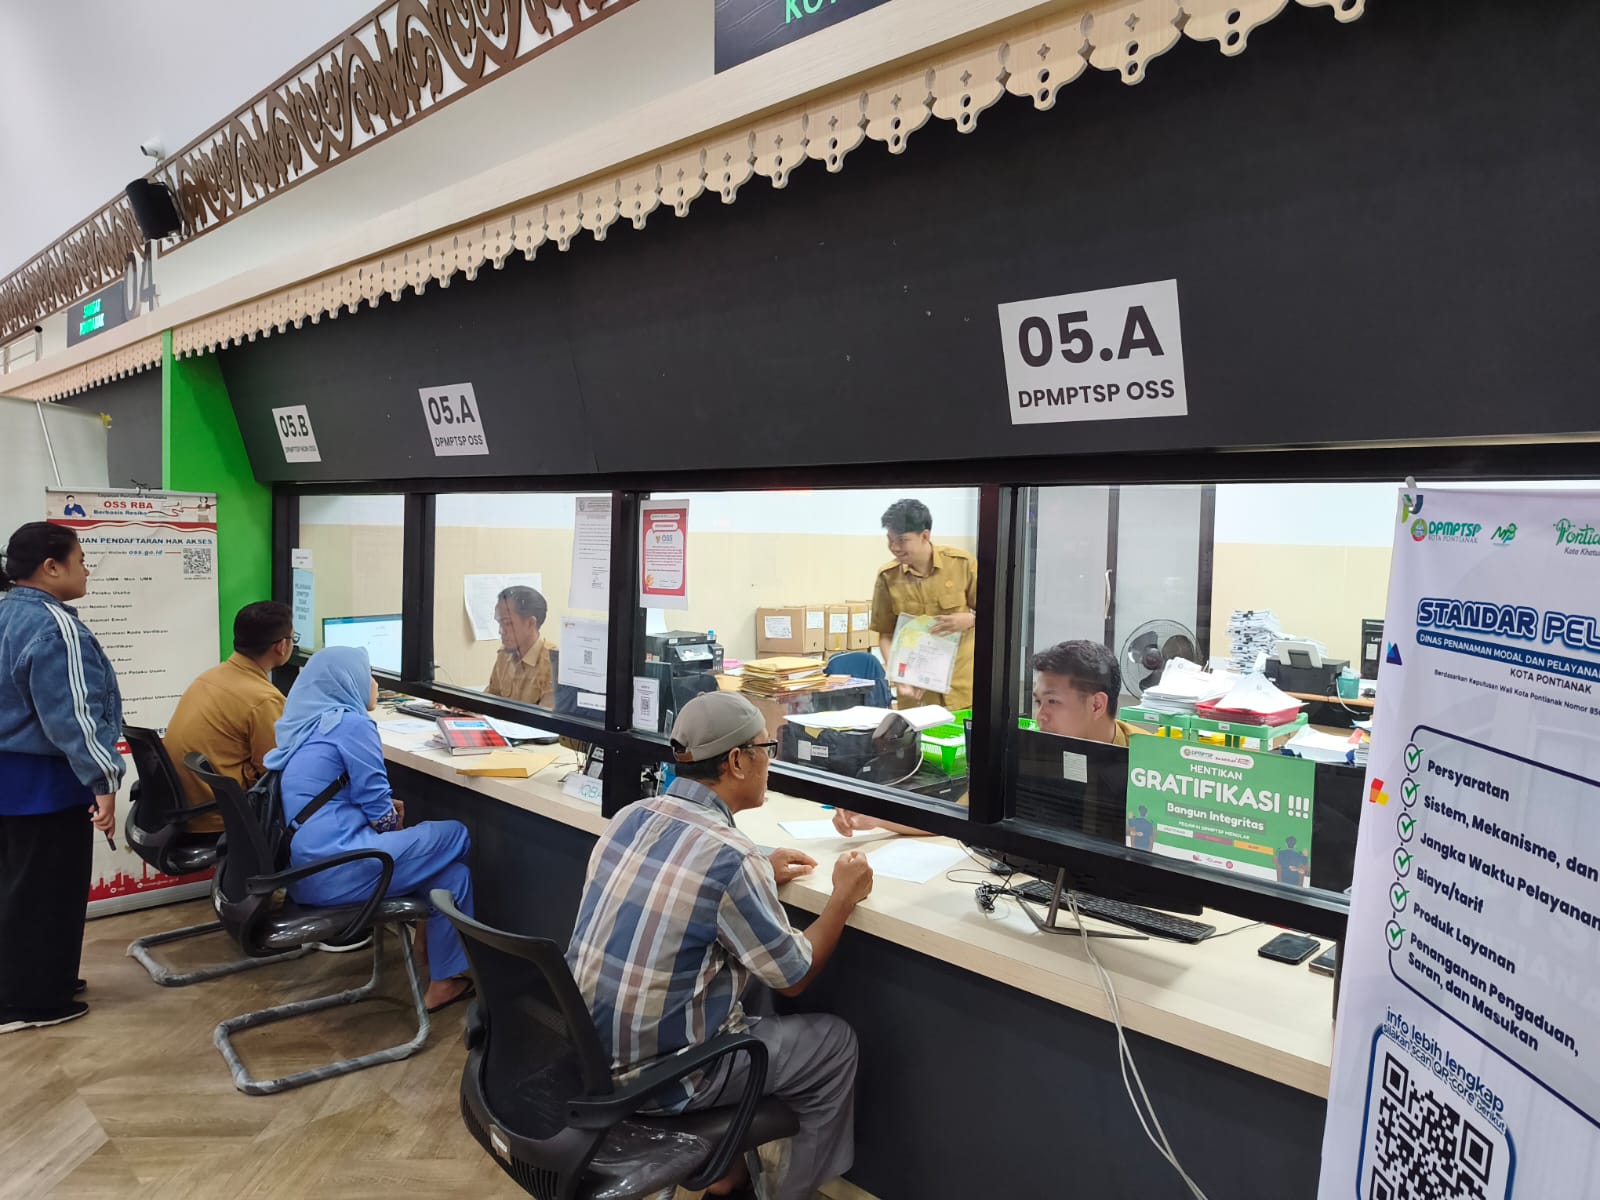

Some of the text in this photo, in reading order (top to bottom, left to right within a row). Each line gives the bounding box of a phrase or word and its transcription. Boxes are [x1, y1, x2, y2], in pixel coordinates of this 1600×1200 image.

[785, 0, 836, 24] KO
[123, 239, 156, 321] 04
[1019, 305, 1165, 367] 05.A
[428, 394, 476, 425] 05.A
[1018, 379, 1175, 408] DPMPTSP OSS
[279, 414, 309, 438] 05.B
[434, 434, 483, 447] DPMPTSP OSS
[131, 501, 153, 509] RBA
[1428, 534, 1478, 544] KOTA PONTIANAK
[1429, 521, 1482, 537] DPMPTSP
[1564, 547, 1579, 555] Kota
[1417, 598, 1538, 641] STANDAR
[1420, 633, 1600, 679] DINAS PENANAMAN MODAL DAN PELAYANA
[1434, 669, 1468, 683] Berdasarkan
[1469, 678, 1498, 690] Keputusan
[1500, 685, 1513, 695] Wali
[1514, 688, 1529, 699] Kota
[1530, 692, 1562, 706] Pontianak
[1564, 698, 1588, 713] Nomor
[1510, 668, 1592, 694] KOTA PONTIANAK
[1130, 767, 1310, 819] GRATIFIKASI !!!
[1190, 764, 1243, 781] HENTIKAN
[1427, 759, 1510, 802] Persyaratan
[1167, 802, 1265, 831] Bangun Integritas
[1424, 795, 1599, 882] Sistem, Mekanisme, dan
[1417, 867, 1484, 914] Biaya/tarif
[1420, 833, 1600, 932] Jangka Waktu Pelayanan
[1413, 902, 1516, 974] Produk Layanan
[1408, 952, 1538, 1051] Saran, dan Masukan
[1410, 933, 1579, 1057] Penanganan Pengaduan,
[1383, 1024, 1505, 1131] silakan scan QR-core berikut
[1387, 1006, 1504, 1113] info lebih lengkap
